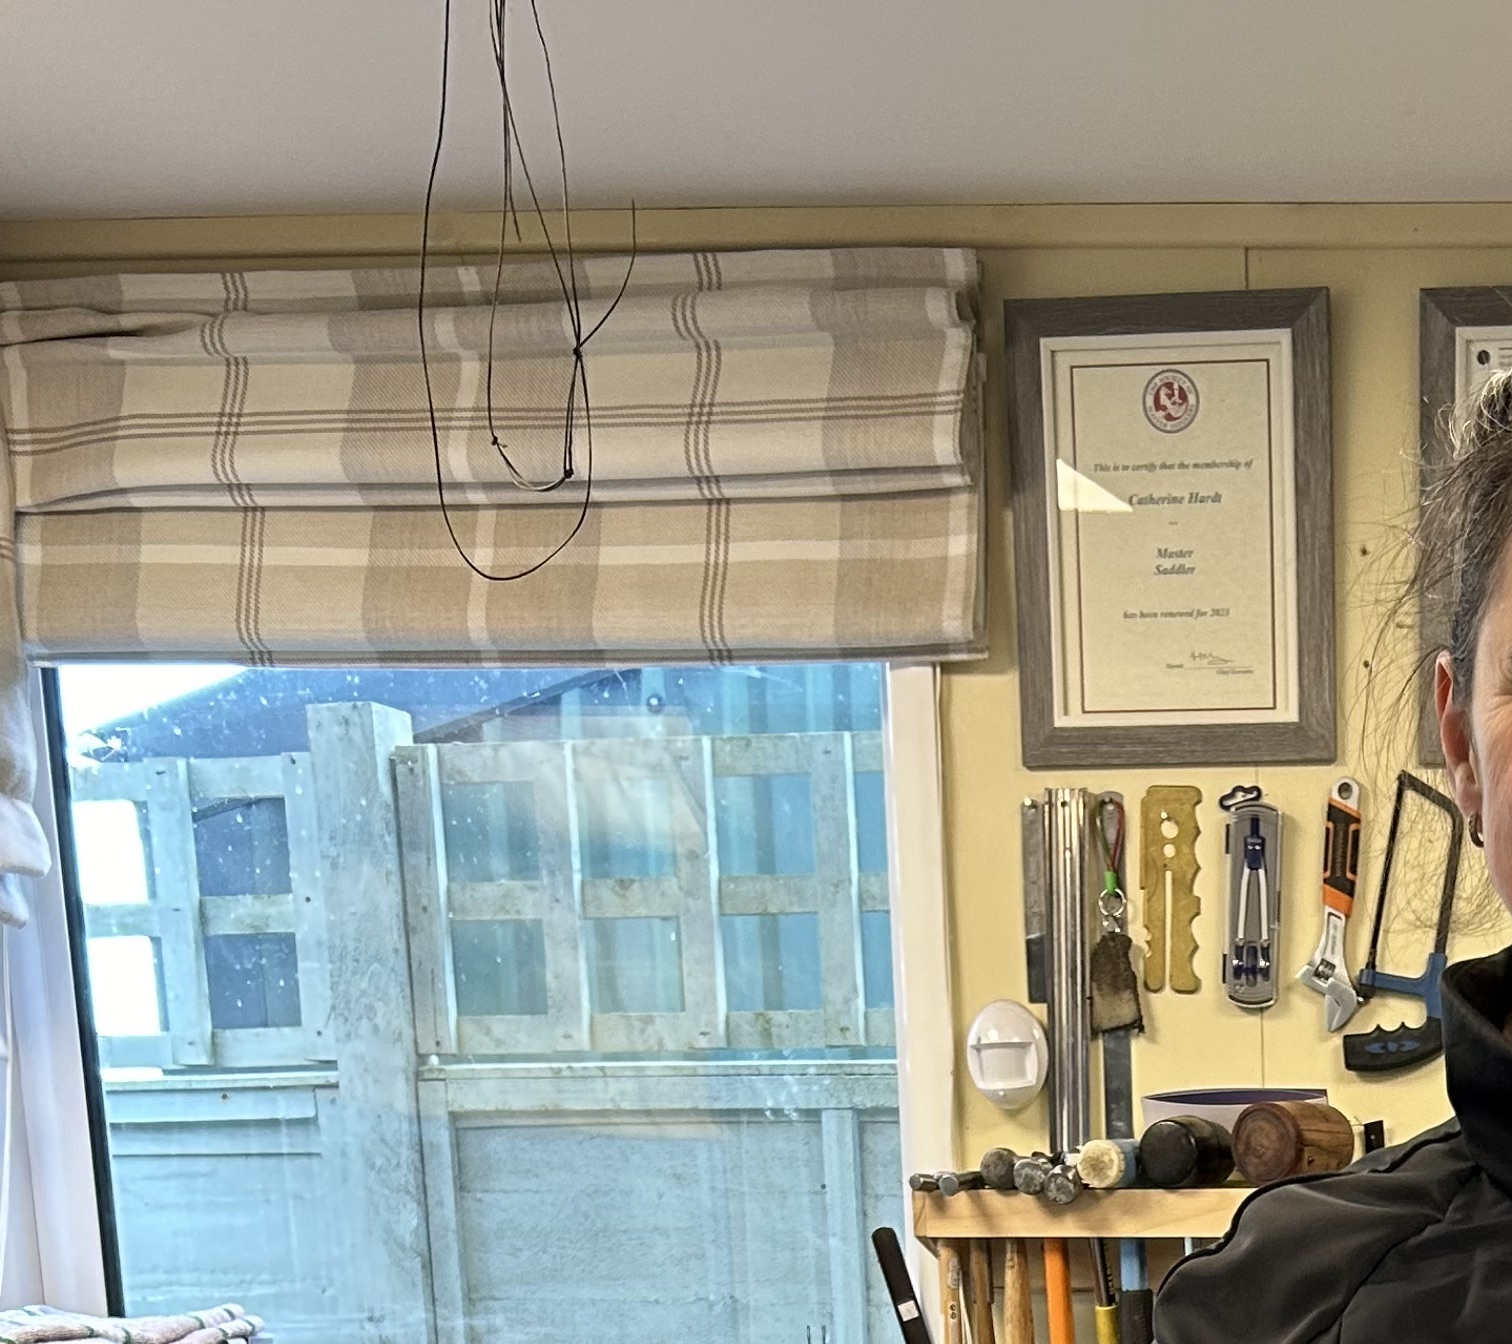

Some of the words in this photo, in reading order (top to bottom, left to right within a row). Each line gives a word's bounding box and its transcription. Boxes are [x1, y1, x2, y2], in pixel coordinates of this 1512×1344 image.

[1129, 492, 1185, 506] Catherine
[1156, 548, 1195, 559] Master
[1153, 563, 1196, 576] Saddler
